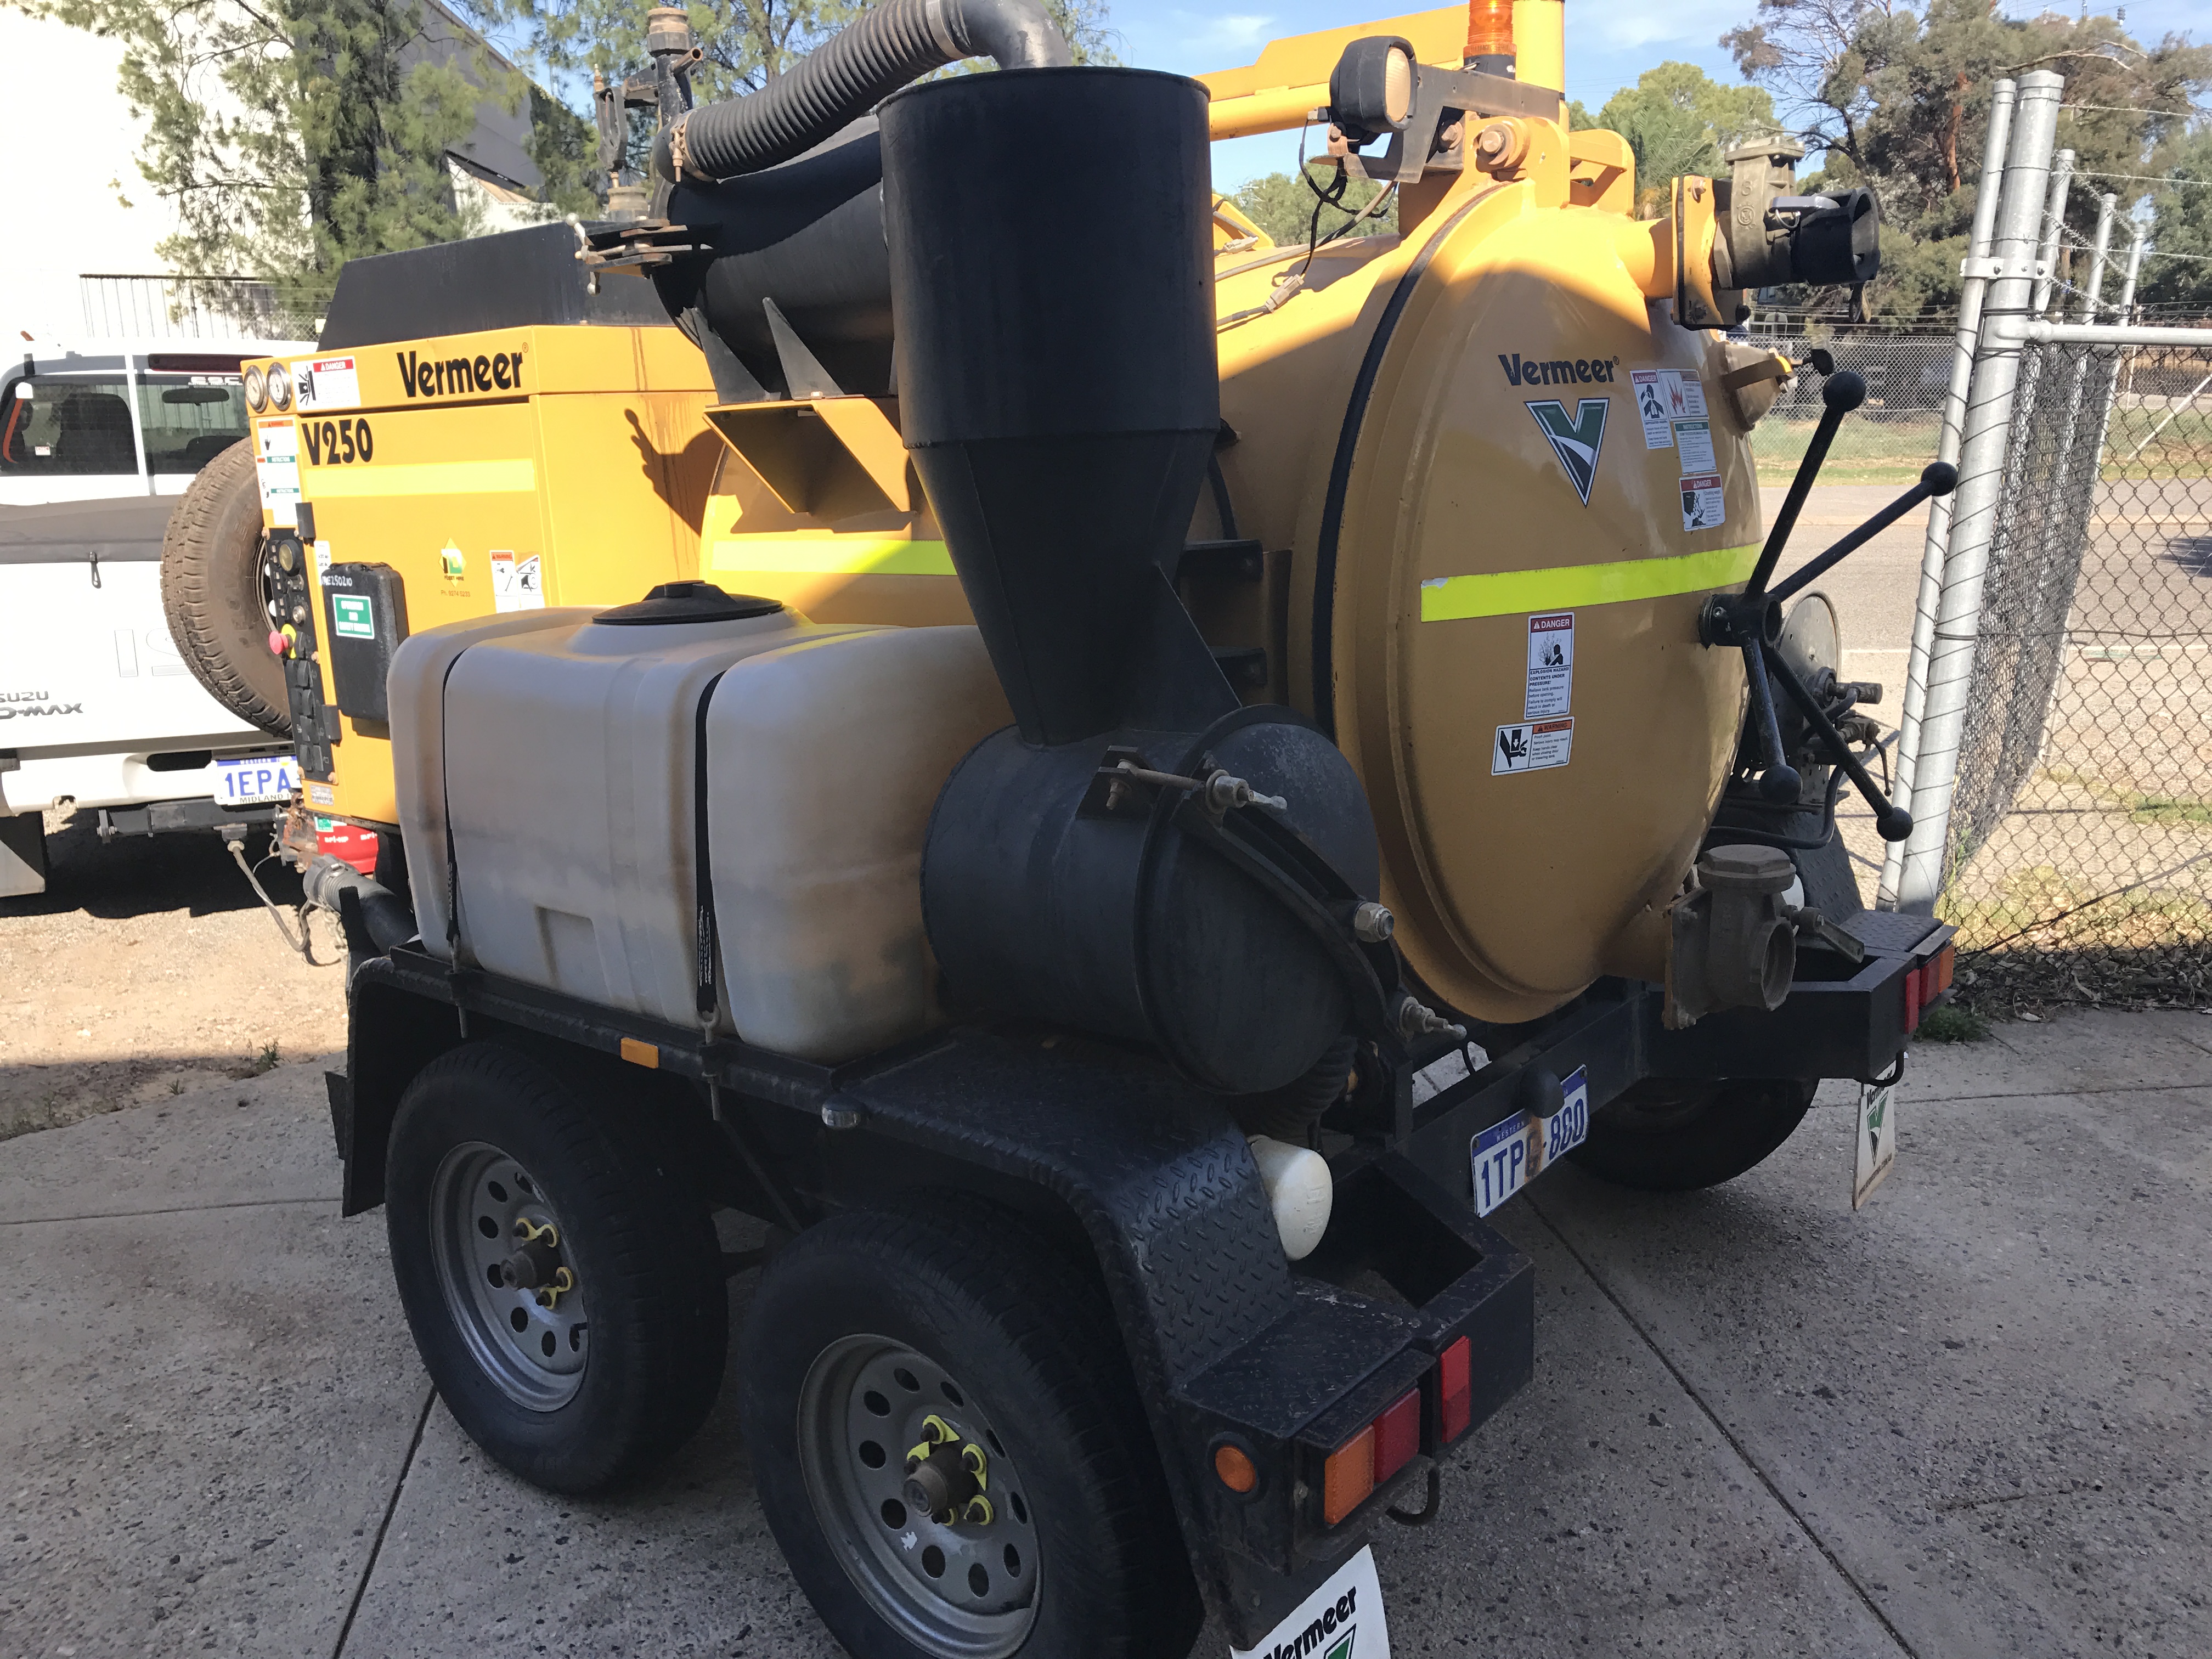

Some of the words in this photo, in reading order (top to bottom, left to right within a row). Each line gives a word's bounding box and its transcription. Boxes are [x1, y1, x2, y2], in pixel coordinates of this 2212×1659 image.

[325, 362, 346, 371] DANGER
[397, 351, 523, 398] Vermeer
[1498, 353, 1615, 386] Vermeer
[301, 417, 374, 466] V250
[1697, 479, 1712, 488] DANGER
[1541, 619, 1570, 629] DANGER
[239, 793, 284, 804] MIDLAND
[1496, 1120, 1525, 1142] WESTERN
